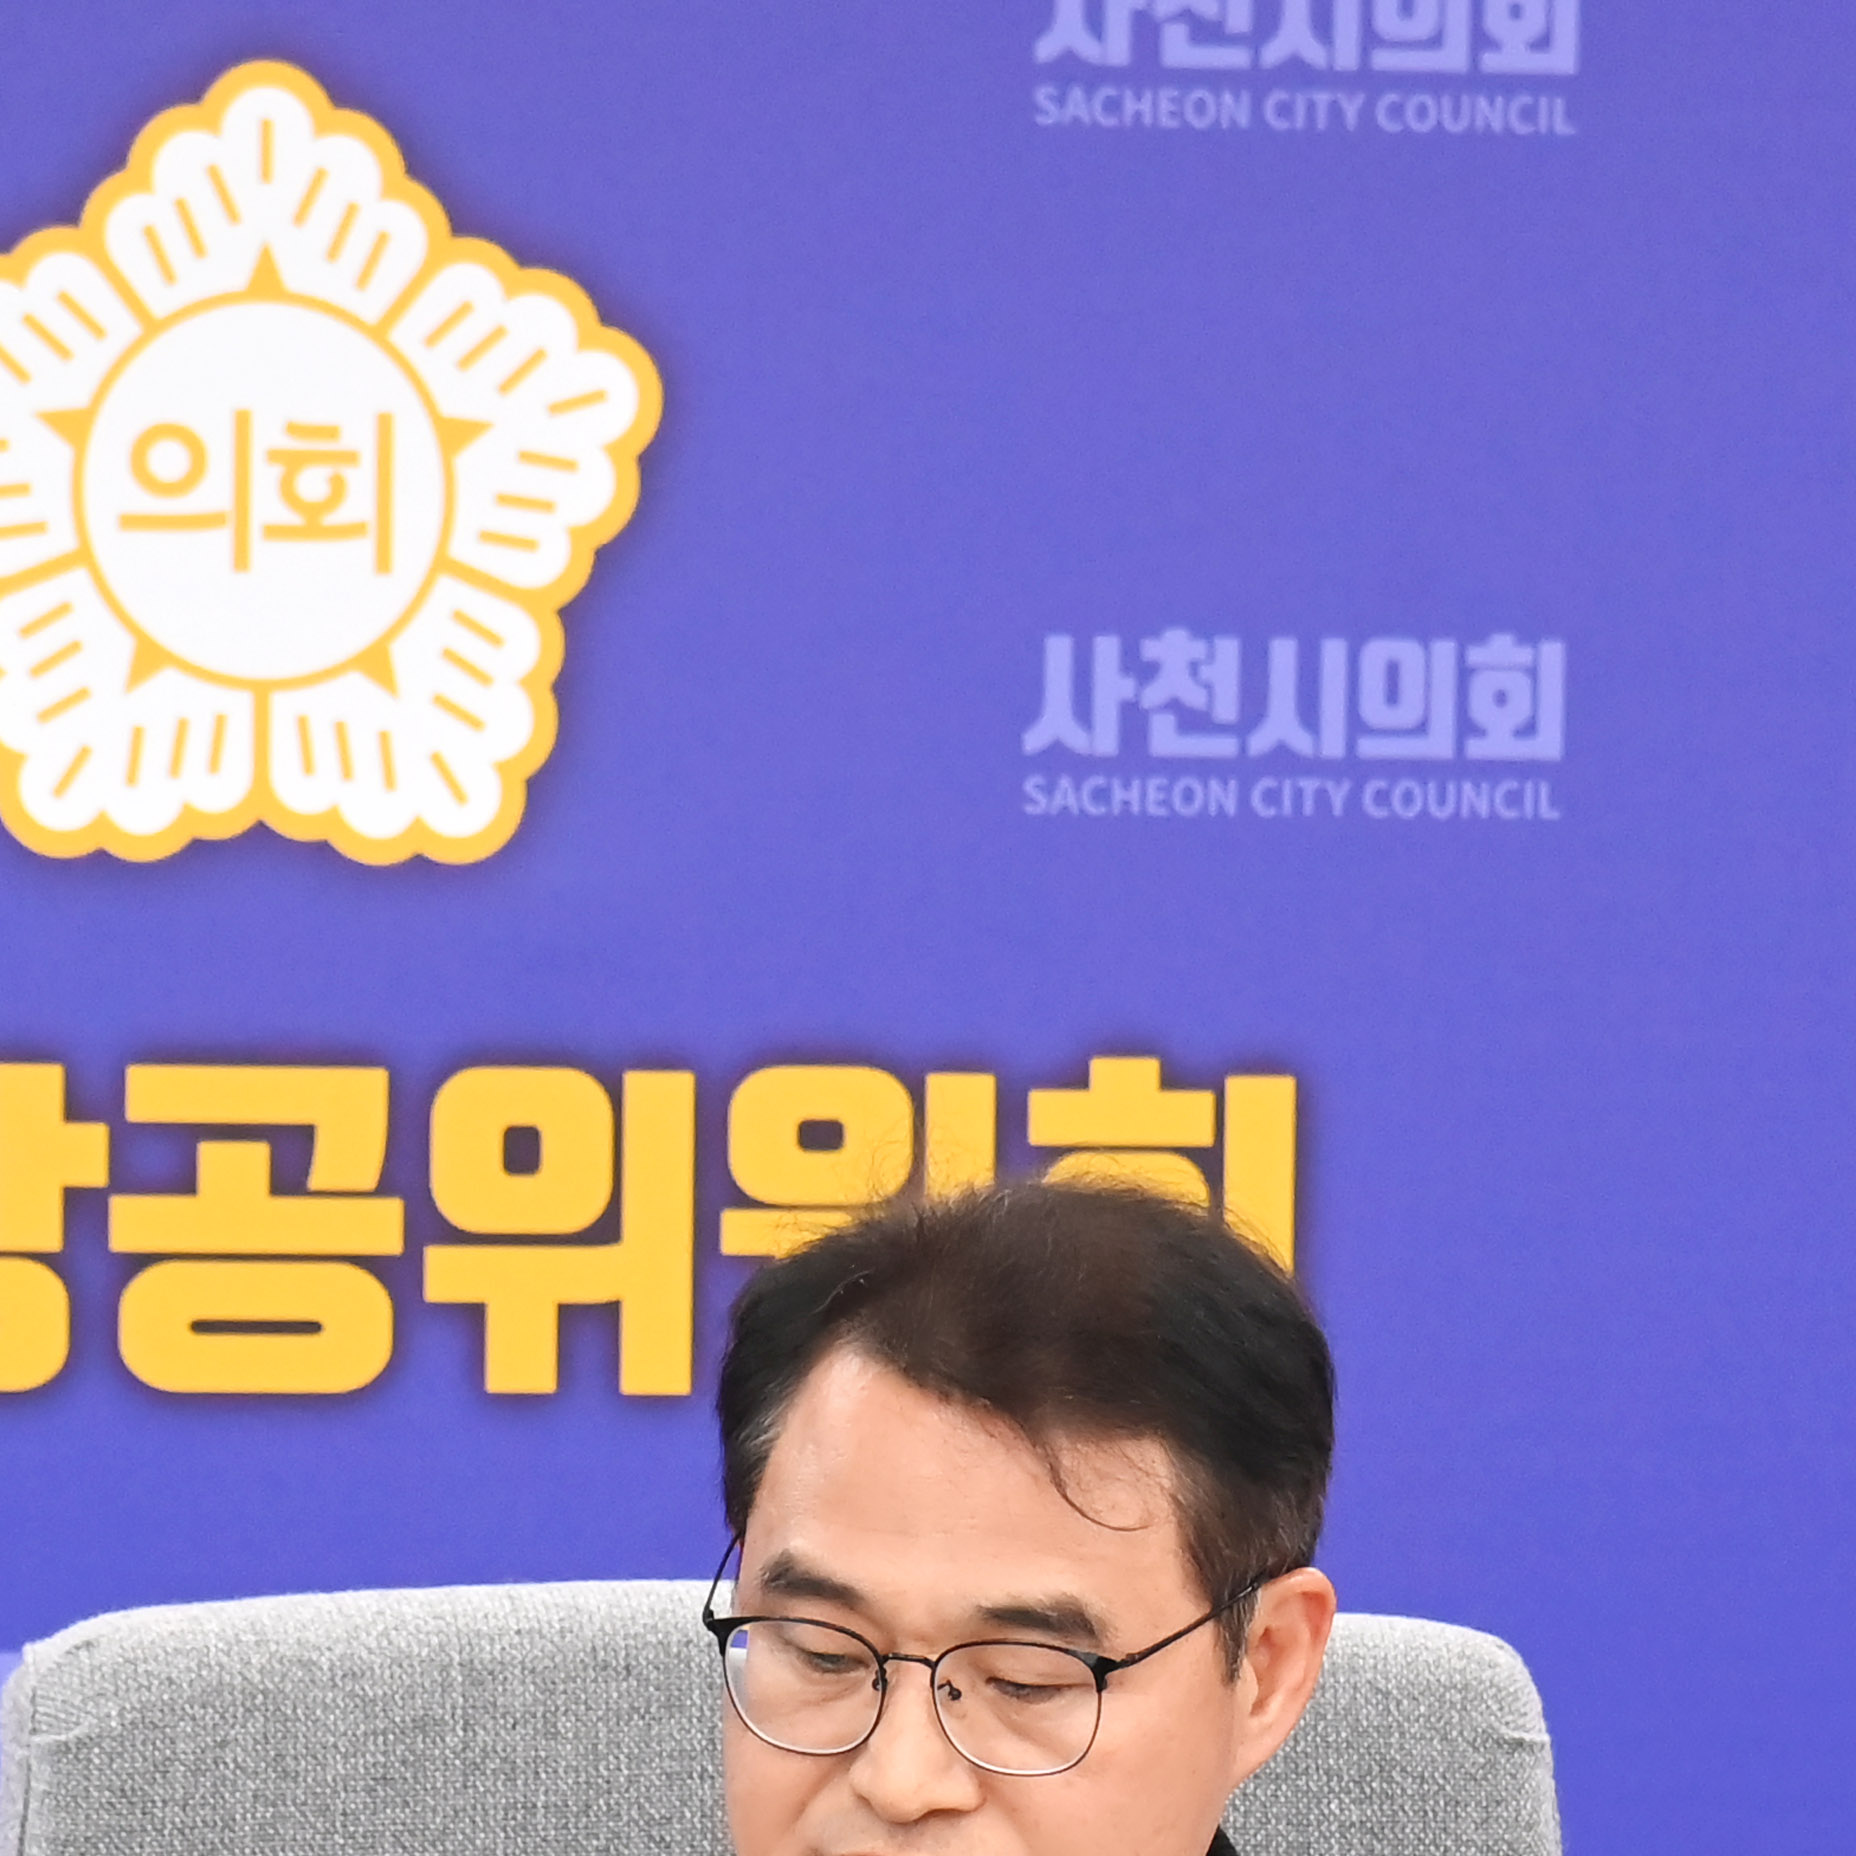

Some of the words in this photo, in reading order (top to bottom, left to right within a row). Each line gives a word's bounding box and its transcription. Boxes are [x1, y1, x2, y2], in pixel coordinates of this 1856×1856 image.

[1034, 85, 1250, 129] SACHEON
[1264, 90, 1365, 130] CITY
[1375, 92, 1575, 135] COUNCIL
[118, 408, 393, 574] 의회
[1022, 626, 1566, 762] 사천시의회
[1023, 774, 1238, 817] SACHEON
[1250, 777, 1351, 818] CITY
[1362, 778, 1560, 820] COUNCIL
